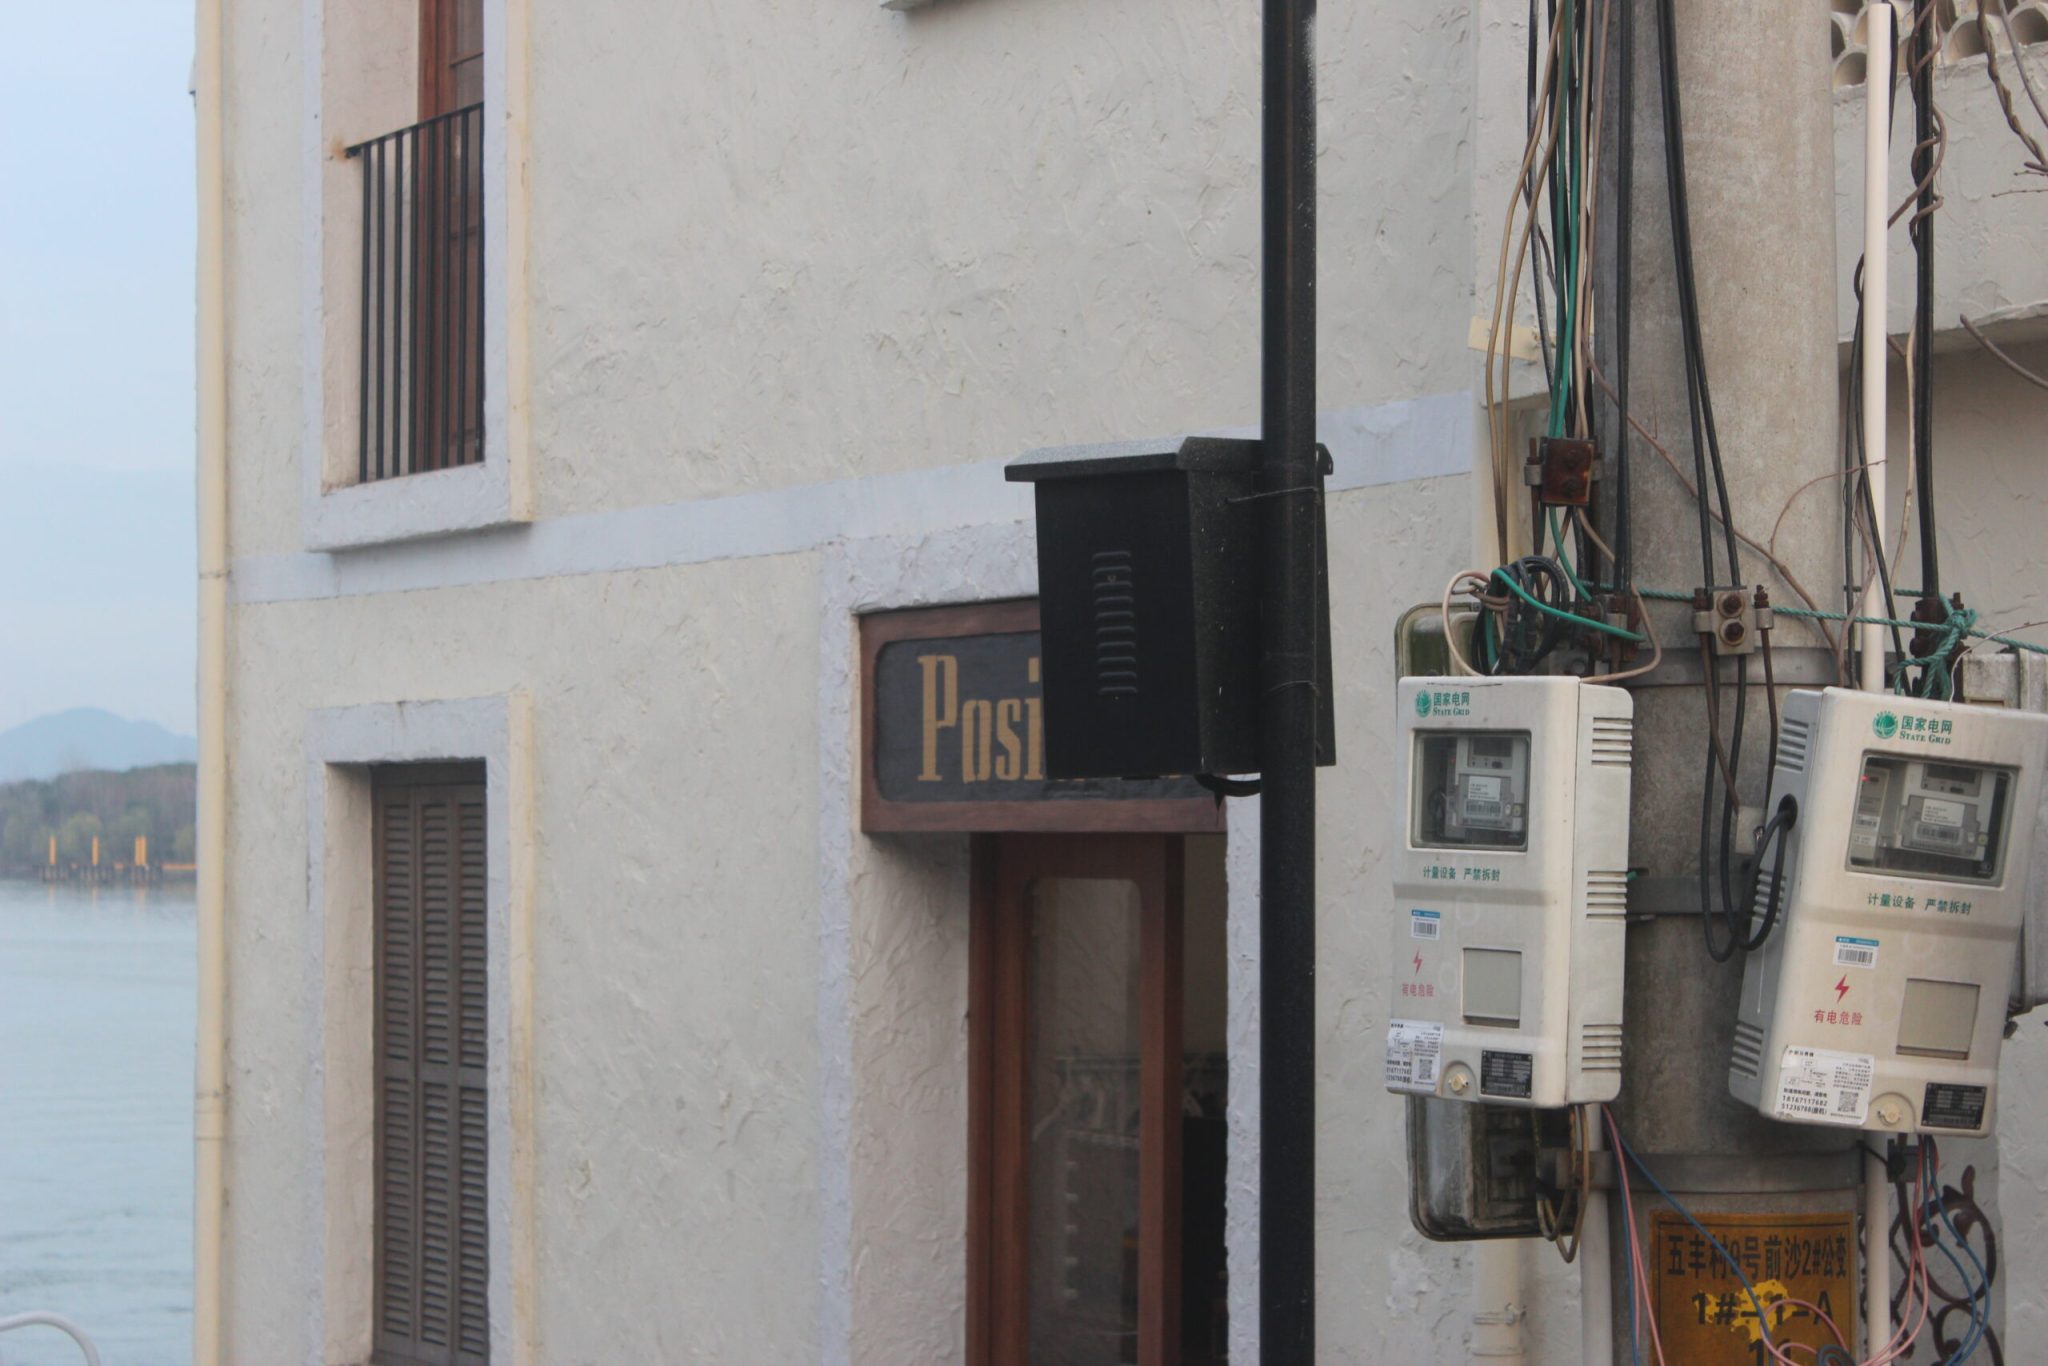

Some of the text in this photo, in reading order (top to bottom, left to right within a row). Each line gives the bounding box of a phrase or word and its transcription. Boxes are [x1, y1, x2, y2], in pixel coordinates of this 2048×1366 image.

[1433, 691, 1470, 706] 国家电网
[916, 654, 1046, 783] Posi
[1901, 715, 1953, 735] 国家电网
[1899, 730, 1952, 745] STATE GRID
[1423, 866, 1501, 882] 计量设备 严禁拆封
[1867, 893, 1972, 916] 计量设备 严禁拆封
[1813, 1009, 1863, 1026] 有电危险
